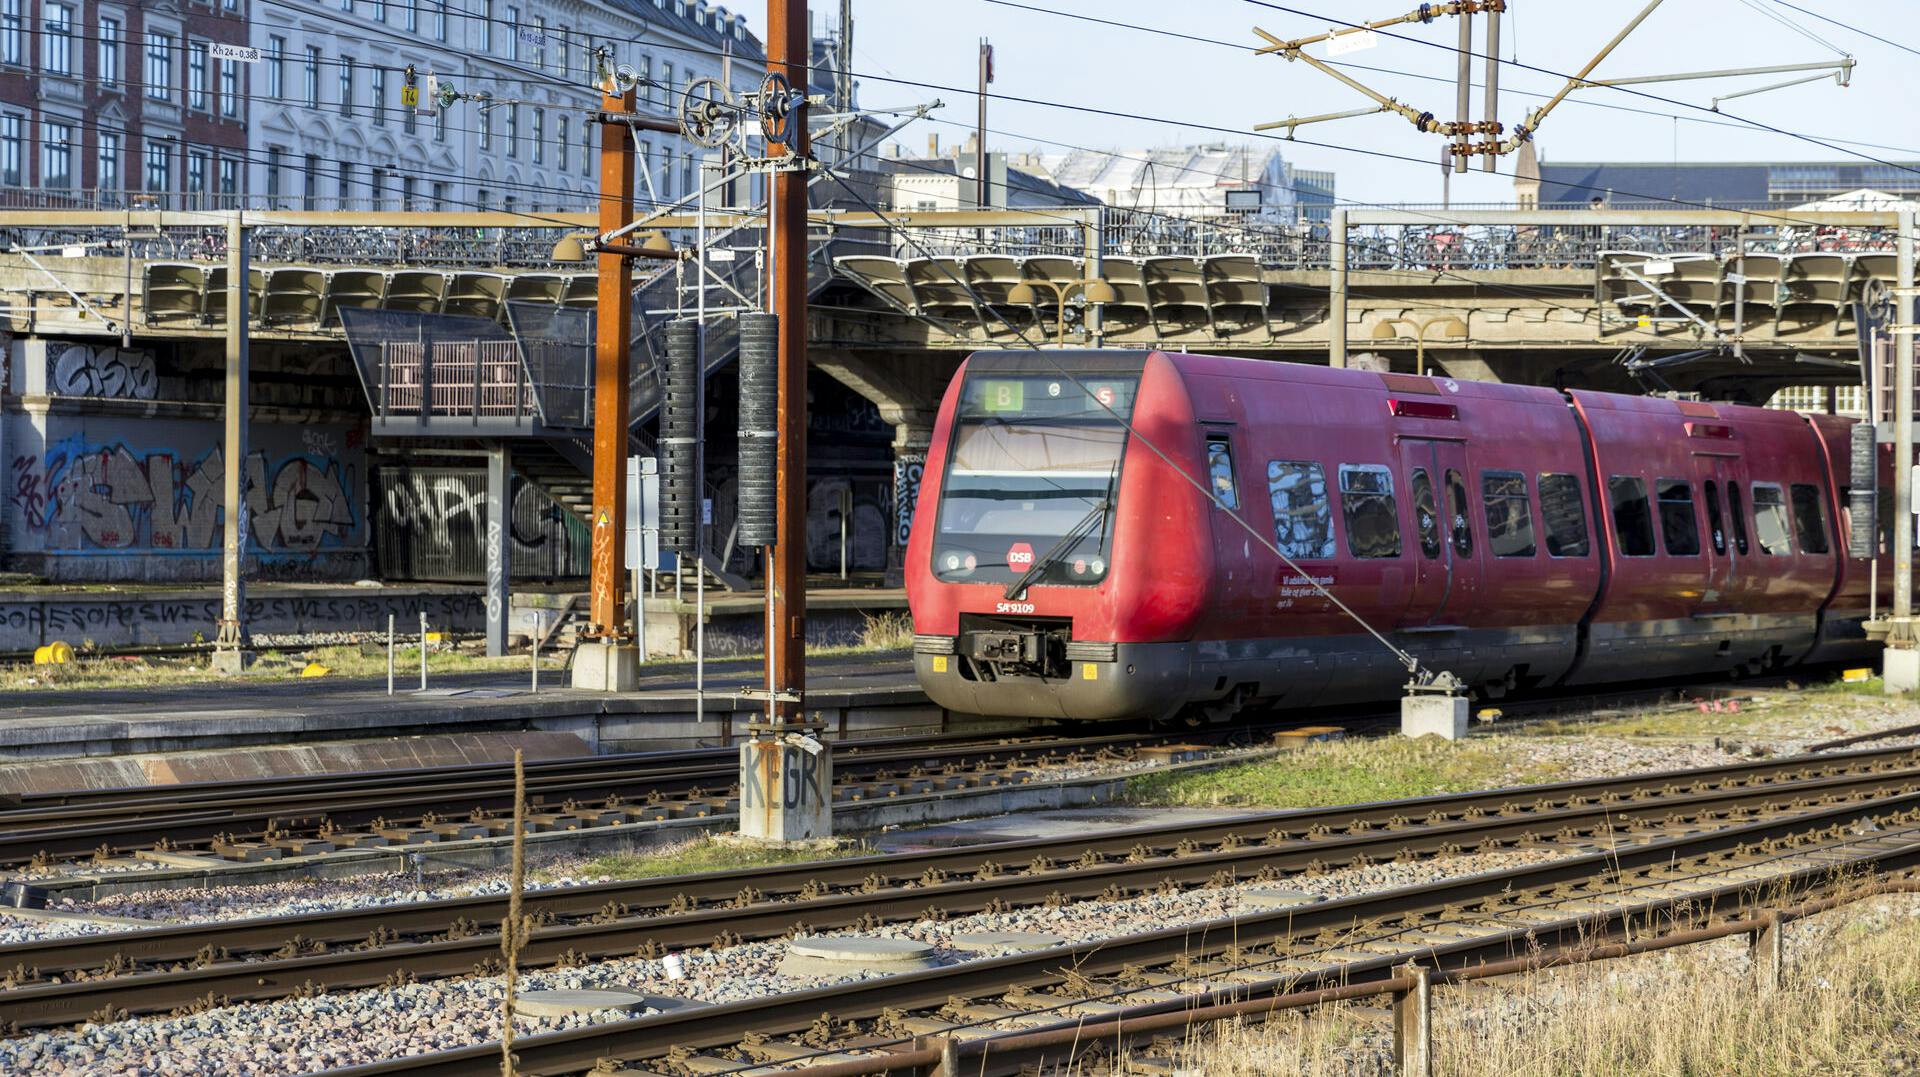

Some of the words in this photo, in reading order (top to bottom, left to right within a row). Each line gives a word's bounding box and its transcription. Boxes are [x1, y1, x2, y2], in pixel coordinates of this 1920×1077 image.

[998, 386, 1010, 406] B
[1099, 390, 1111, 405] S
[1010, 552, 1031, 563] DSB
[1010, 603, 1034, 613] 9109
